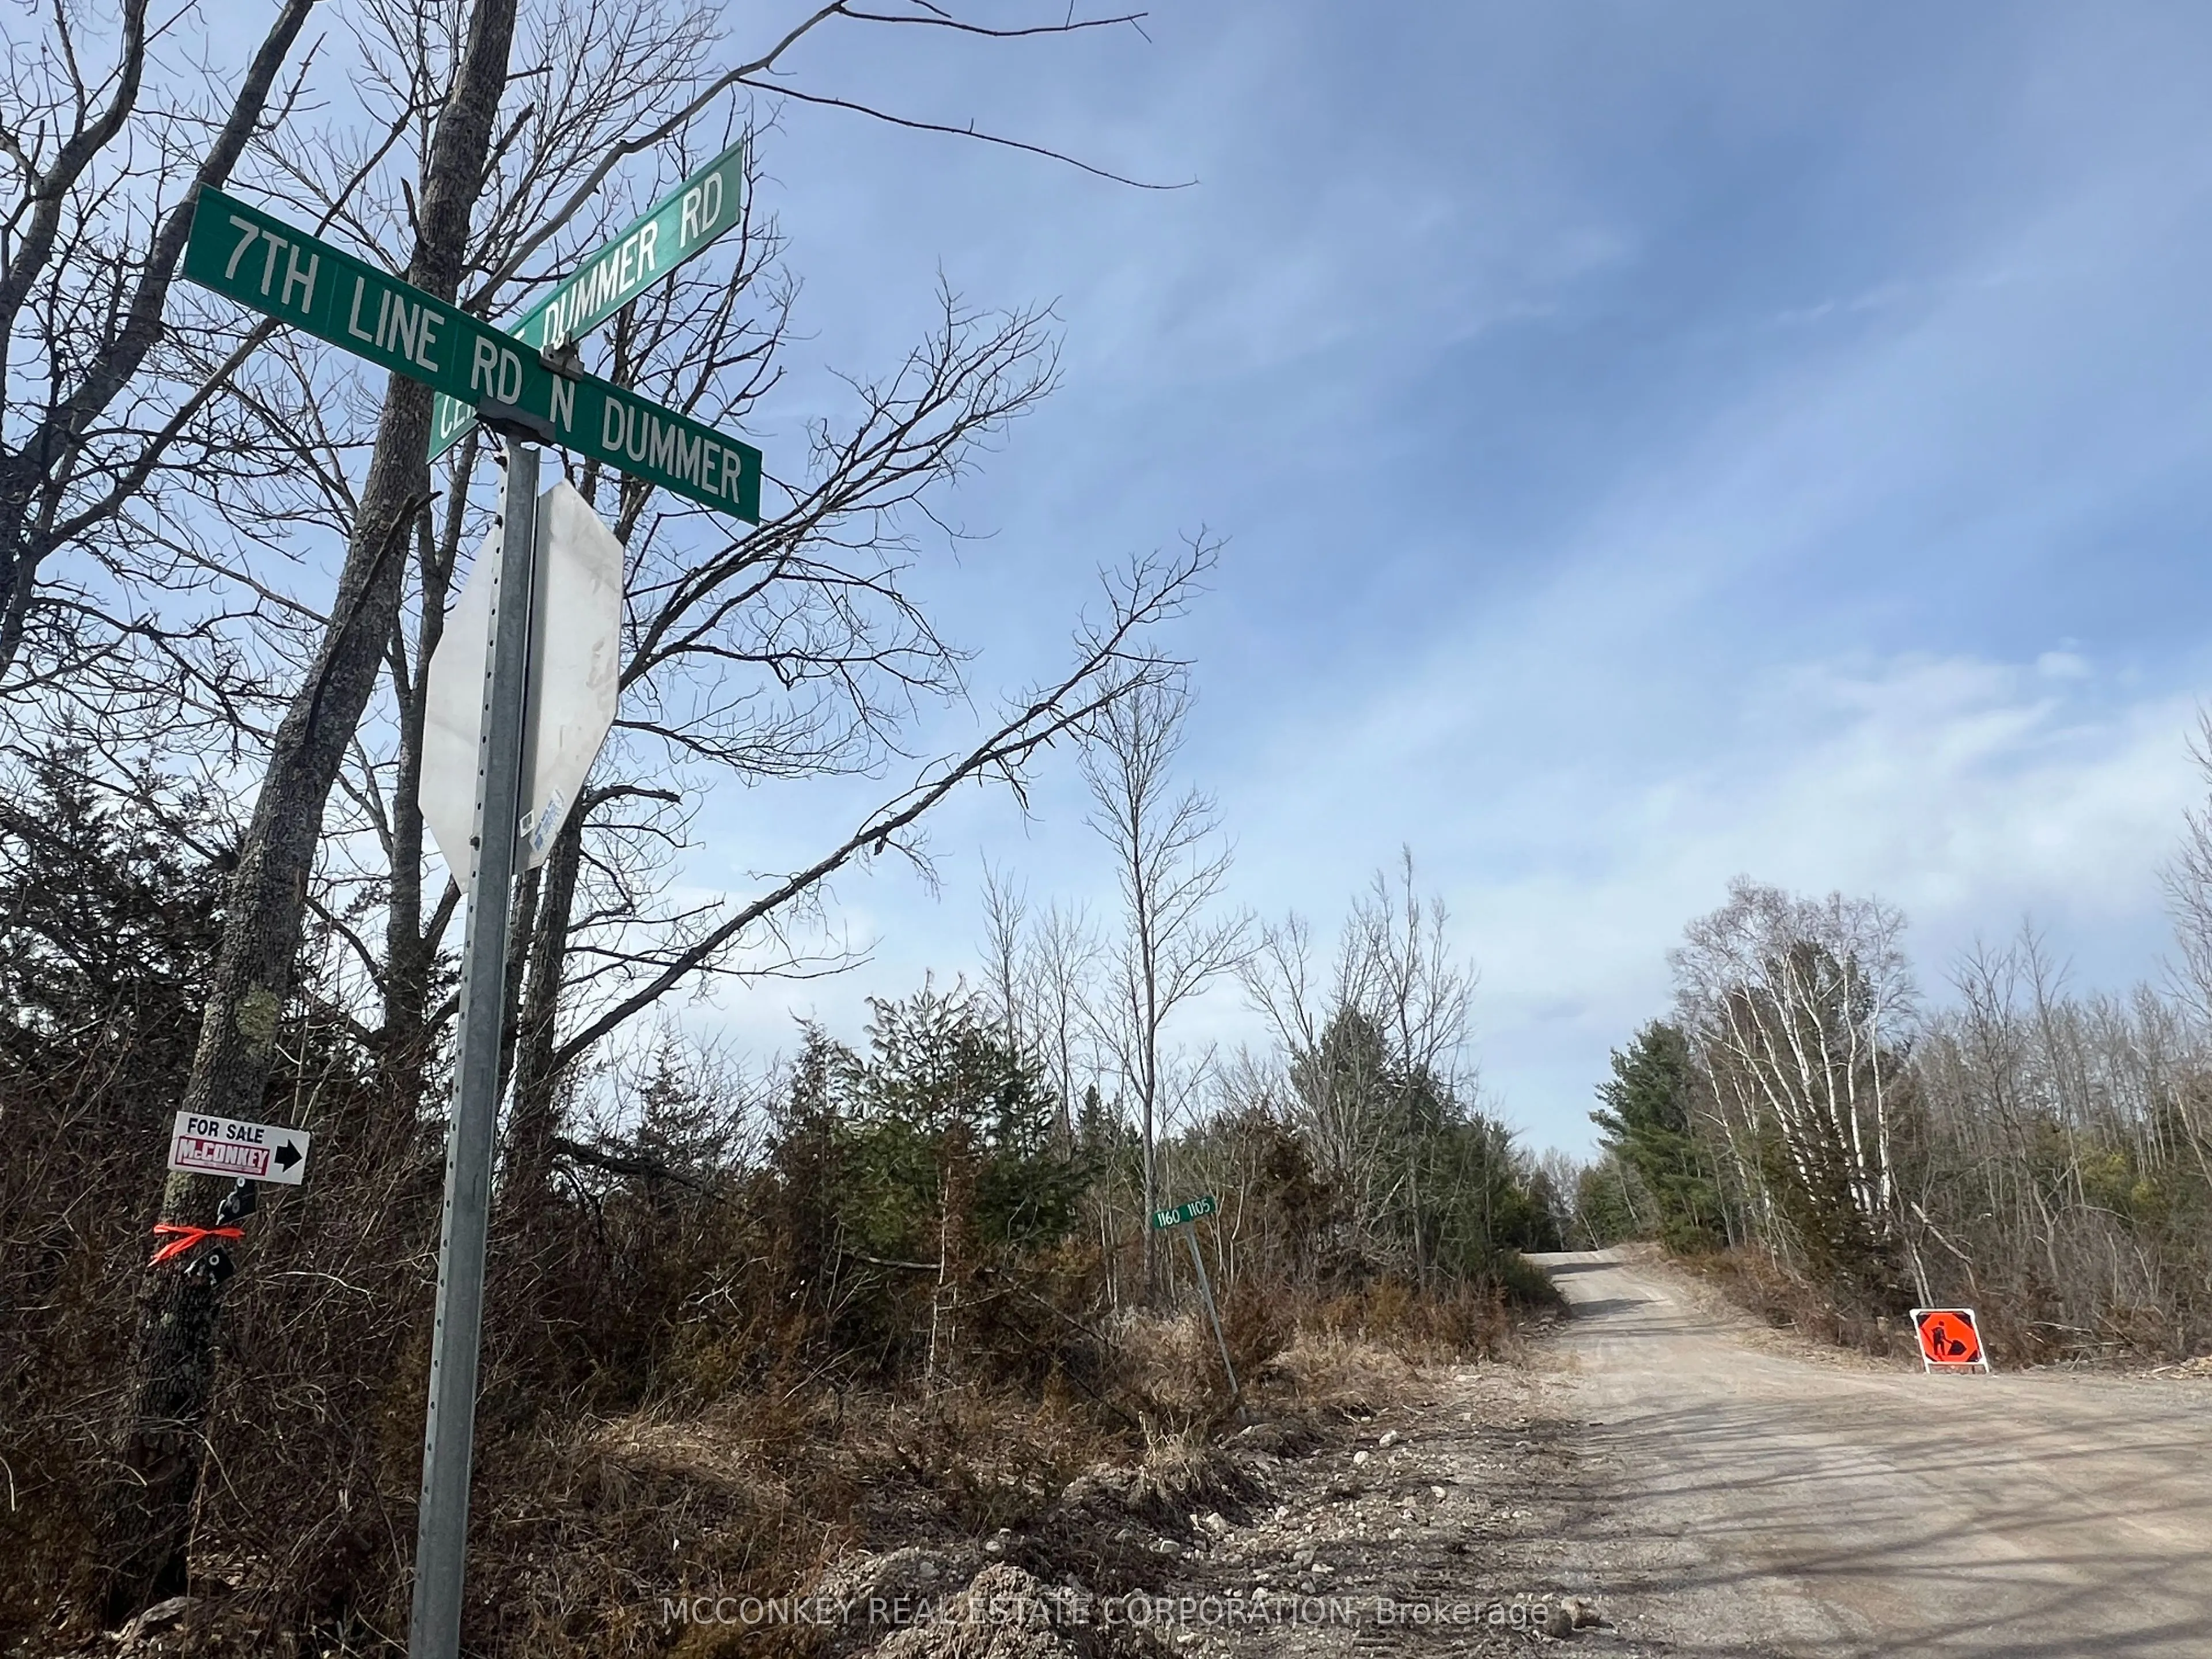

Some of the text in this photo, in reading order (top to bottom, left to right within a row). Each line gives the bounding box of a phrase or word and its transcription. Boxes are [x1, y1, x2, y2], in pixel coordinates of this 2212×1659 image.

[543, 172, 724, 350] DUMMER RD
[224, 214, 319, 314] 7TH
[348, 275, 446, 373] LINE
[471, 335, 522, 405] RD
[549, 372, 574, 433] N
[601, 396, 742, 505] DUMMER
[187, 1117, 264, 1143] FOR SALE
[1157, 1198, 1210, 1228] 1160 1105
